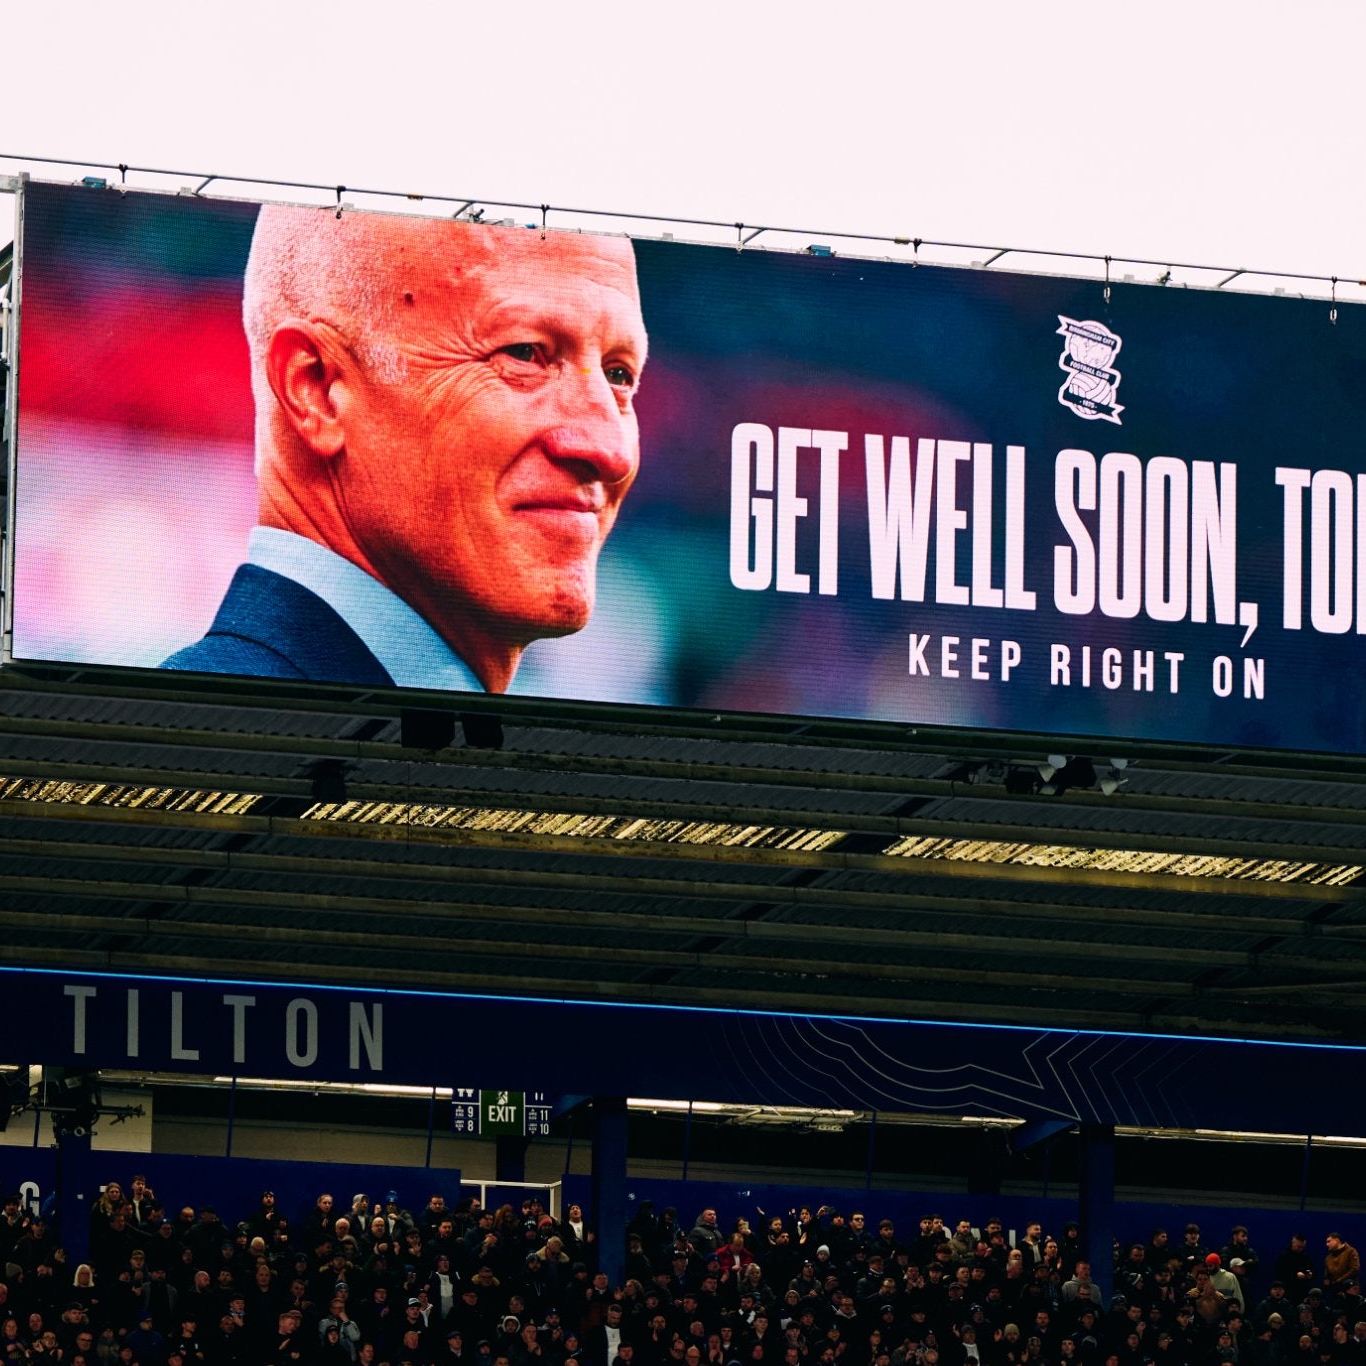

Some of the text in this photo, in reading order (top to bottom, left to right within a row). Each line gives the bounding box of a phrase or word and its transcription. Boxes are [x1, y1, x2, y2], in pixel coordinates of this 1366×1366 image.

[1069, 360, 1096, 375] FOOTBALL
[729, 422, 848, 595] GET
[864, 434, 1037, 609] WELL
[1054, 447, 1260, 647] SOON,
[908, 633, 1266, 700] KEEP RIGHT ON
[63, 985, 384, 1072] TILTON
[467, 1106, 474, 1118] 9
[488, 1105, 517, 1123] EXIT
[539, 1109, 549, 1121] 11
[467, 1119, 474, 1132] 8
[539, 1123, 550, 1135] 10
